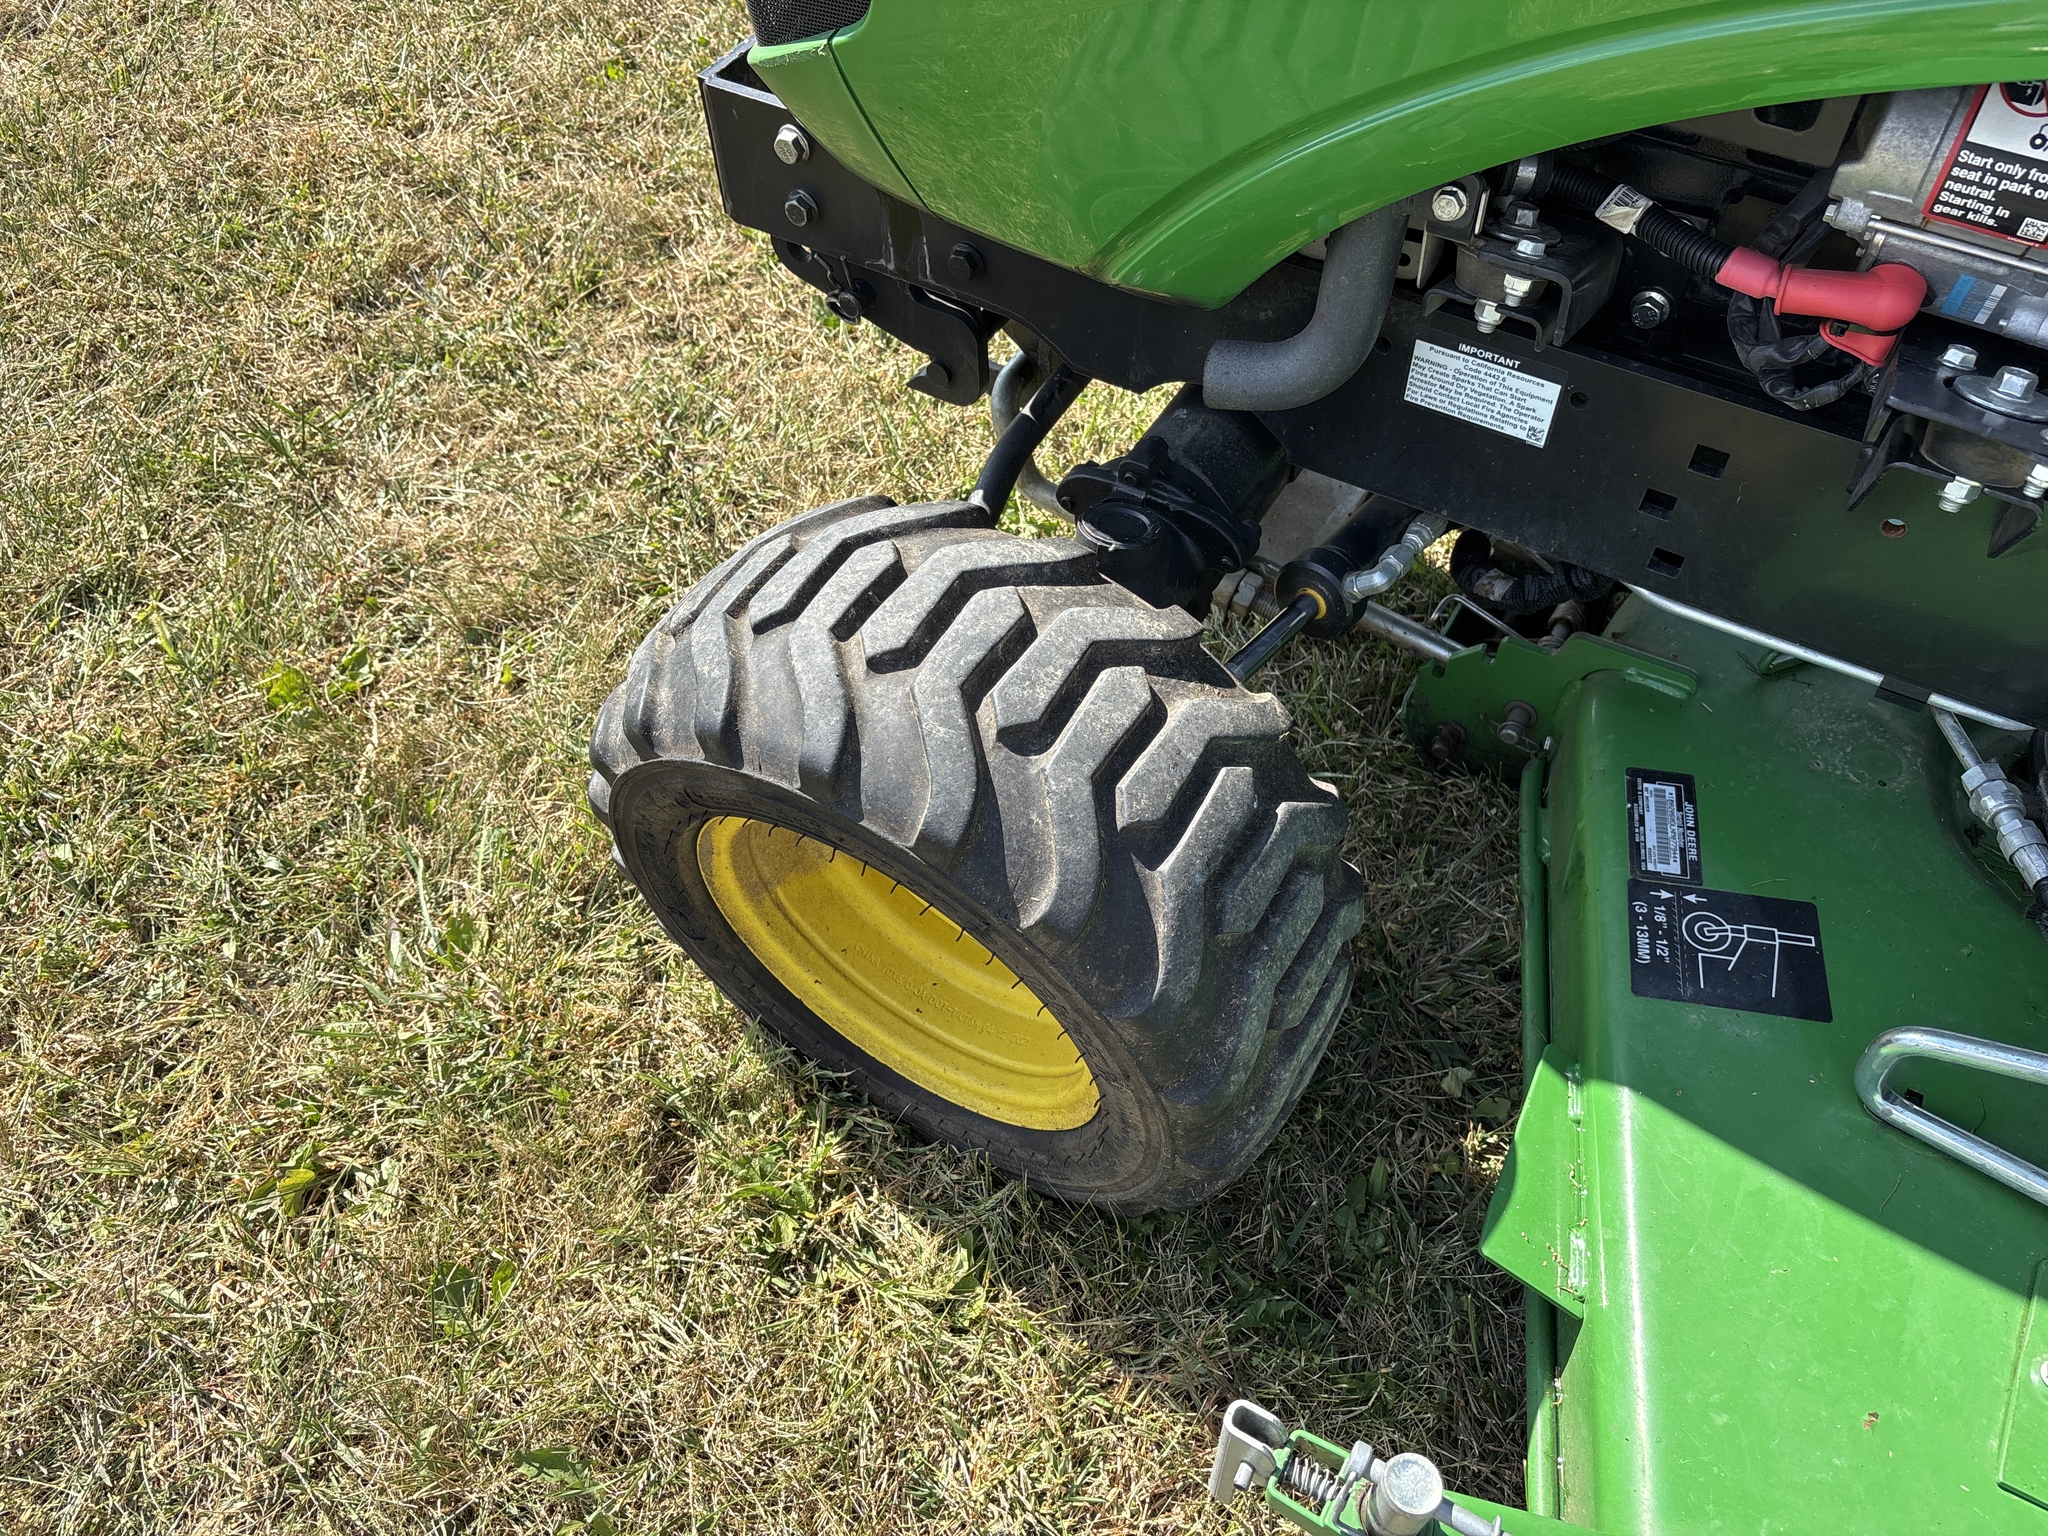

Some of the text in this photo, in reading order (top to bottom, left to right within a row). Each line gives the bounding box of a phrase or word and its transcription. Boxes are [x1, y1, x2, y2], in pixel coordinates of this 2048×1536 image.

[1950, 166, 1983, 183] seat
[1982, 172, 1999, 187] in
[1997, 179, 2034, 196] park
[1957, 149, 2048, 184] Start only fro
[1938, 190, 2011, 219] Starting in
[1943, 180, 1996, 202] neutral.
[1932, 203, 1998, 227] gear kills.
[1428, 345, 1461, 361] Pursuant
[1470, 359, 1505, 375] California
[1506, 371, 1545, 388] Resources
[1458, 342, 1521, 369] IMPORTANT
[1463, 364, 1507, 383] Code 4442.6
[1409, 374, 1545, 423] Arrestor May be Required. The Operator
[1410, 367, 1428, 378] Fires
[1428, 374, 1455, 387] Around
[1455, 382, 1469, 392] Dry
[1469, 387, 1506, 404] Vegetation.
[1515, 402, 1537, 414] Spark
[1411, 361, 1527, 404] May Create Sparks That Can Start
[1413, 354, 1448, 371] WARNING
[1453, 367, 1488, 384] Operation
[1498, 382, 1513, 392] This
[1514, 387, 1554, 405] Equipment
[1405, 393, 1505, 431] Fire Prevention Requirements.
[1406, 386, 1419, 395] For
[1419, 391, 1438, 402] Laws
[1447, 400, 1488, 419] Regulations
[1489, 414, 1518, 430] Relating
[1408, 380, 1528, 425] Should Contact Local Fire Agencies
[1684, 801, 1698, 862] JOHN DEERE
[1631, 901, 1648, 914] (3
[1634, 924, 1651, 964] 13MM)
